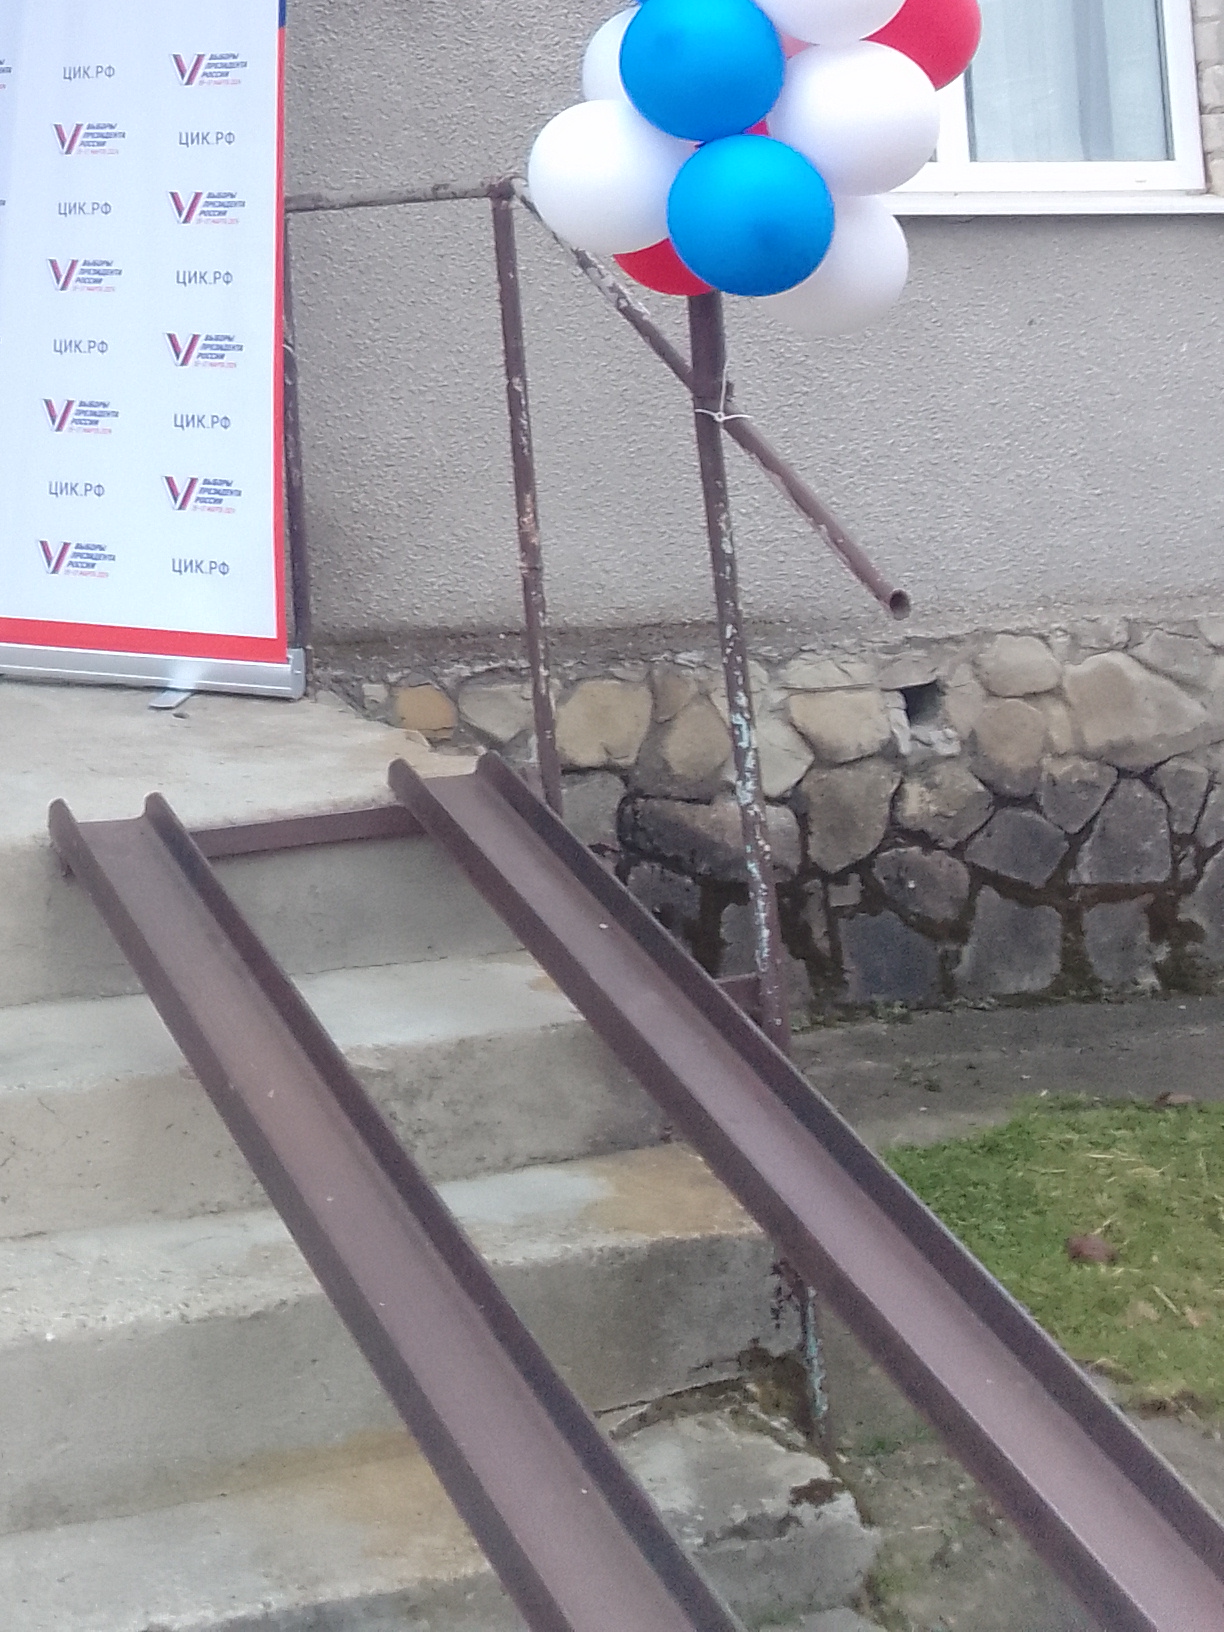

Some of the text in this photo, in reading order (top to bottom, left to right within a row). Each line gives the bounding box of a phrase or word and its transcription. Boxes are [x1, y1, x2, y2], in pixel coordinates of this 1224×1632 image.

[62, 65, 115, 81] ЦИК.РФ
[178, 131, 235, 148] ЦИК.РФ
[58, 201, 112, 217] ЦИК.РФ
[176, 270, 233, 287] ЦИК.РФ
[52, 339, 109, 355] ЦИК.РФ
[174, 414, 231, 431] ЦИК.РФ
[48, 480, 105, 498] ЦИК.РФ
[171, 558, 230, 576] ЦИК.РФ
